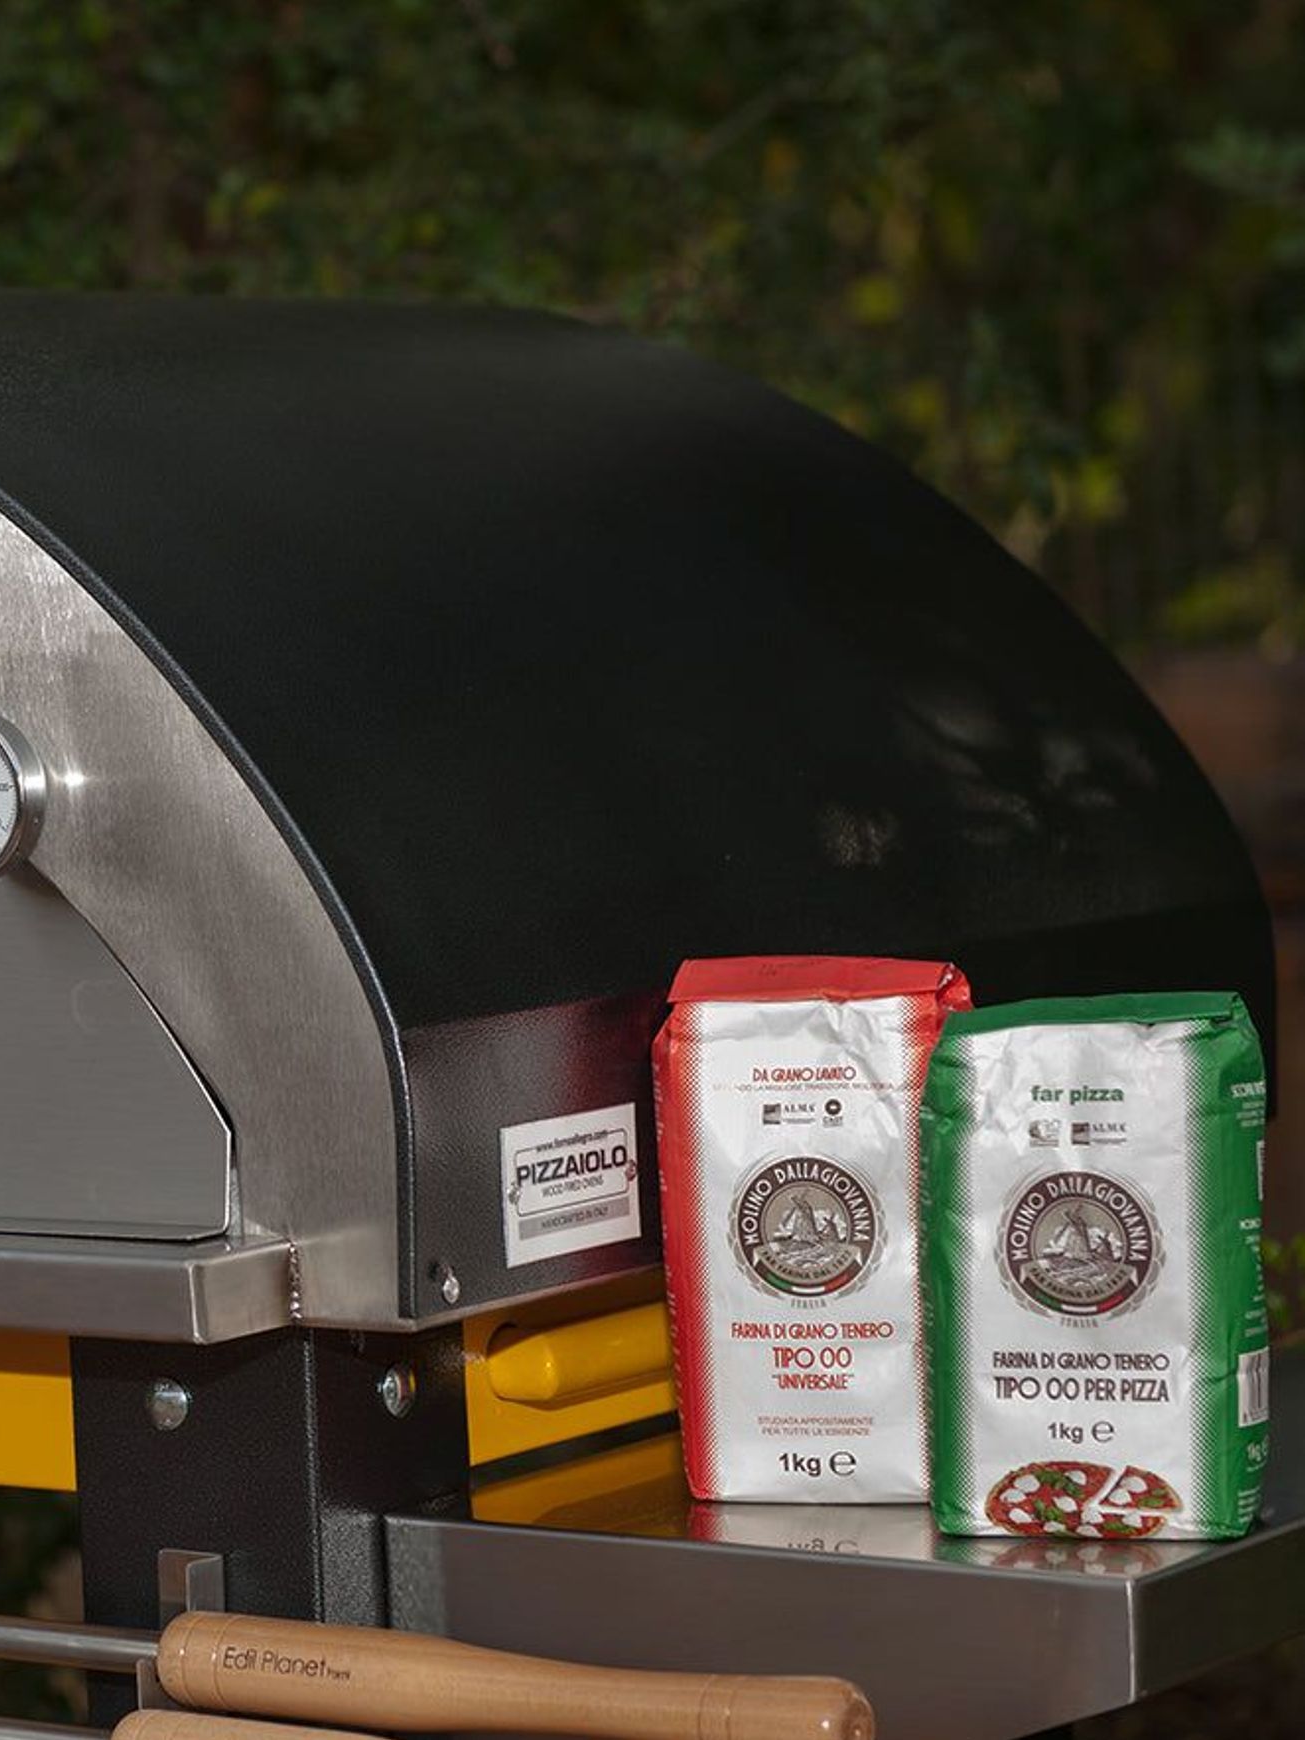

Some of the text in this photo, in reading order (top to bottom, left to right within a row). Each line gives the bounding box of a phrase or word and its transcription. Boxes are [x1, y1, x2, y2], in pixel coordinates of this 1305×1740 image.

[752, 1065, 857, 1082] DA GRANO LAVATO
[1030, 1085, 1125, 1106] far pizza
[516, 1145, 627, 1187] PIZZAIOLO
[741, 1162, 871, 1245] MOLINO DALLAGIOVANNA
[1009, 1176, 1148, 1262] MOLINO DALLAGIOVANNA
[731, 1321, 894, 1340] FARINA DI GRANO TENERO
[772, 1346, 815, 1369] TIPO
[993, 1352, 1170, 1372] FARINA DI GRANO TENERO
[993, 1376, 1041, 1400] TIPO
[1084, 1379, 1117, 1401] PER
[1120, 1379, 1170, 1402] PIZZA
[1048, 1422, 1085, 1444] 1kg
[779, 1452, 822, 1478] 1kg
[260, 1649, 327, 1677] Planet
